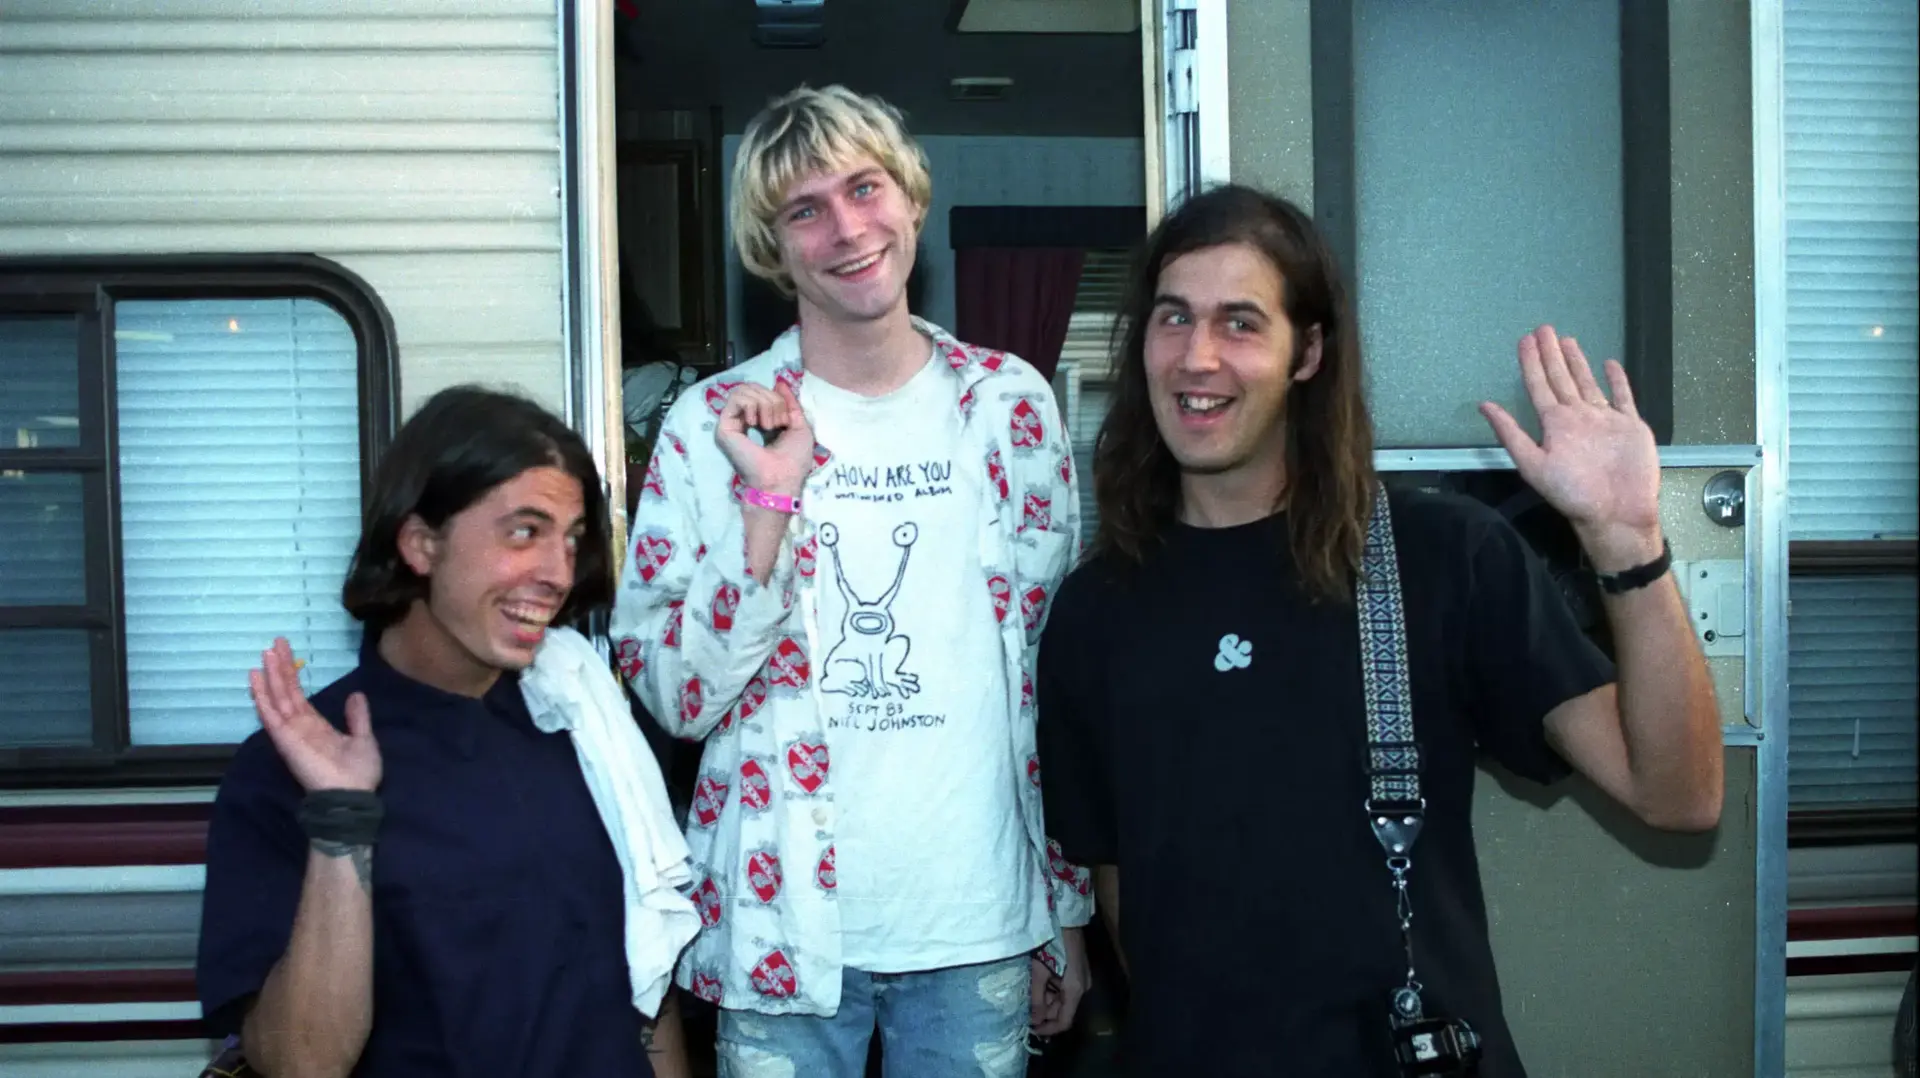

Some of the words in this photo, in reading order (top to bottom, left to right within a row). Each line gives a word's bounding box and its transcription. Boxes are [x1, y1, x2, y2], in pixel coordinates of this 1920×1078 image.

[834, 463, 878, 489] HOW
[886, 464, 916, 489] ARE
[918, 460, 952, 483] YOU
[867, 714, 946, 732] JOHNSTON
